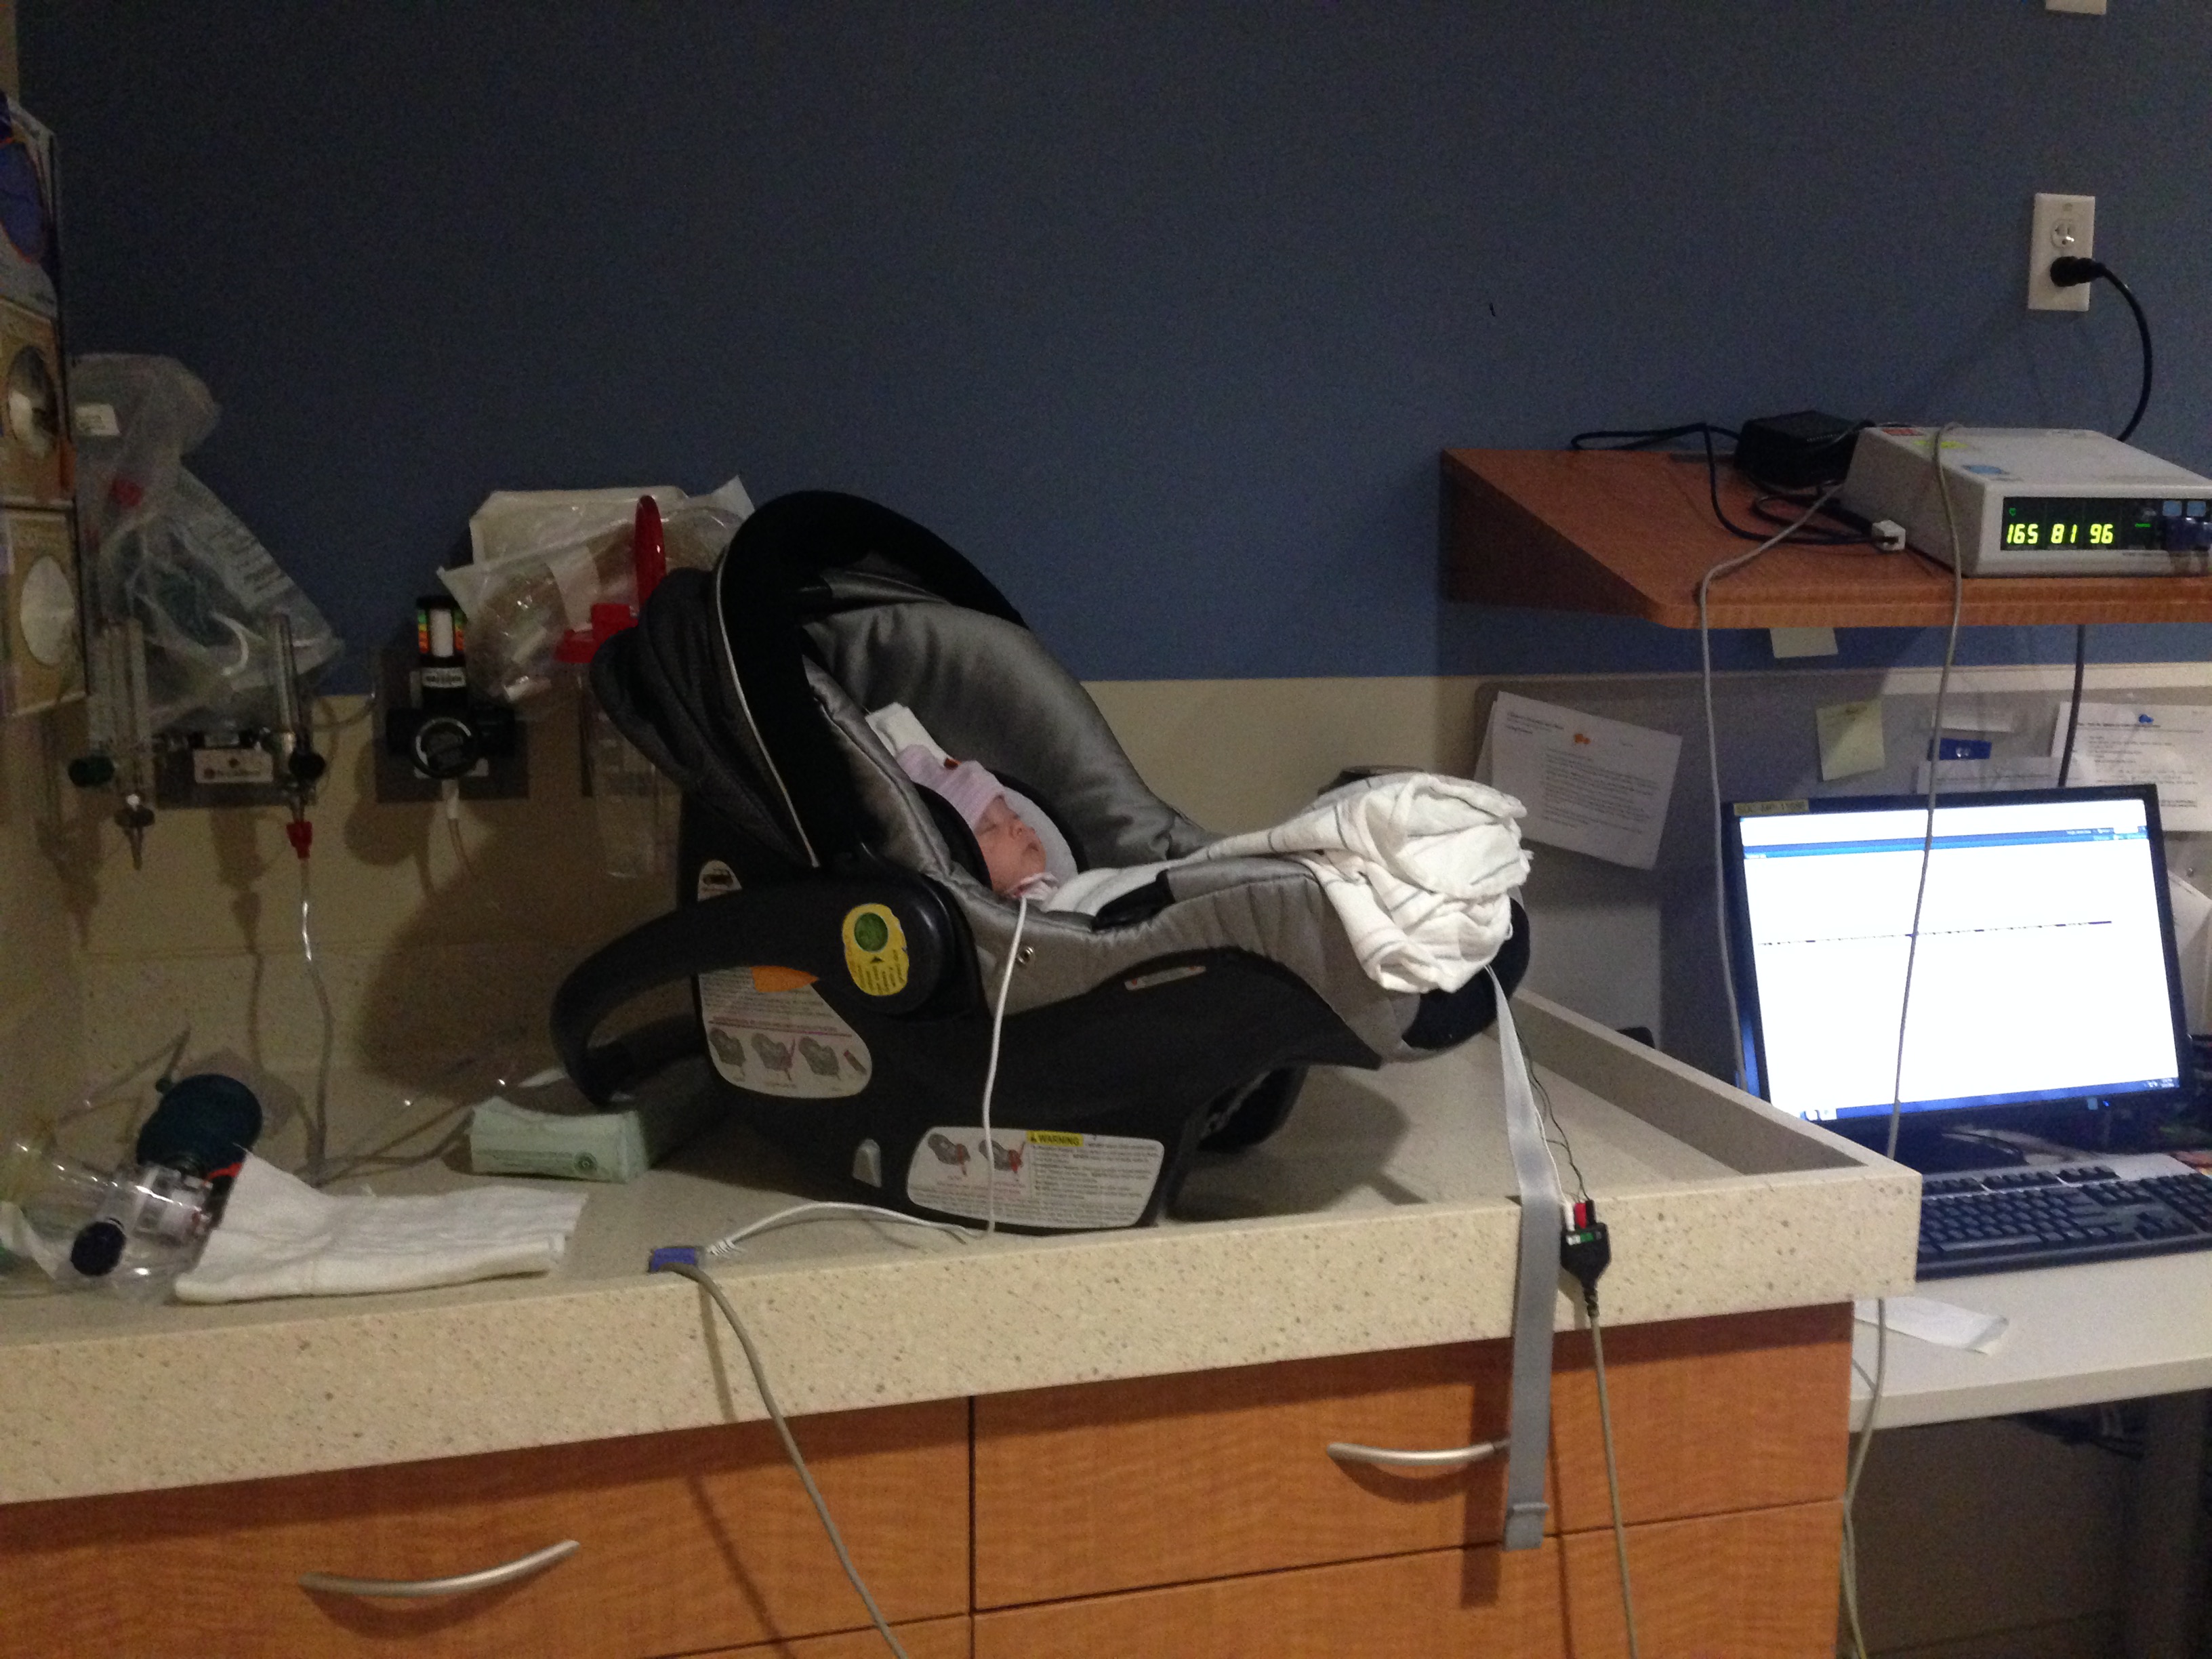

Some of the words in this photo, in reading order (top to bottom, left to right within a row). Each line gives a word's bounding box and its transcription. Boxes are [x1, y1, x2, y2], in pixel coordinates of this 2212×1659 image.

[2006, 524, 2039, 544] 165
[2051, 524, 2078, 544] 81
[2090, 524, 2114, 544] 96
[1038, 1134, 1080, 1146] WARNING
